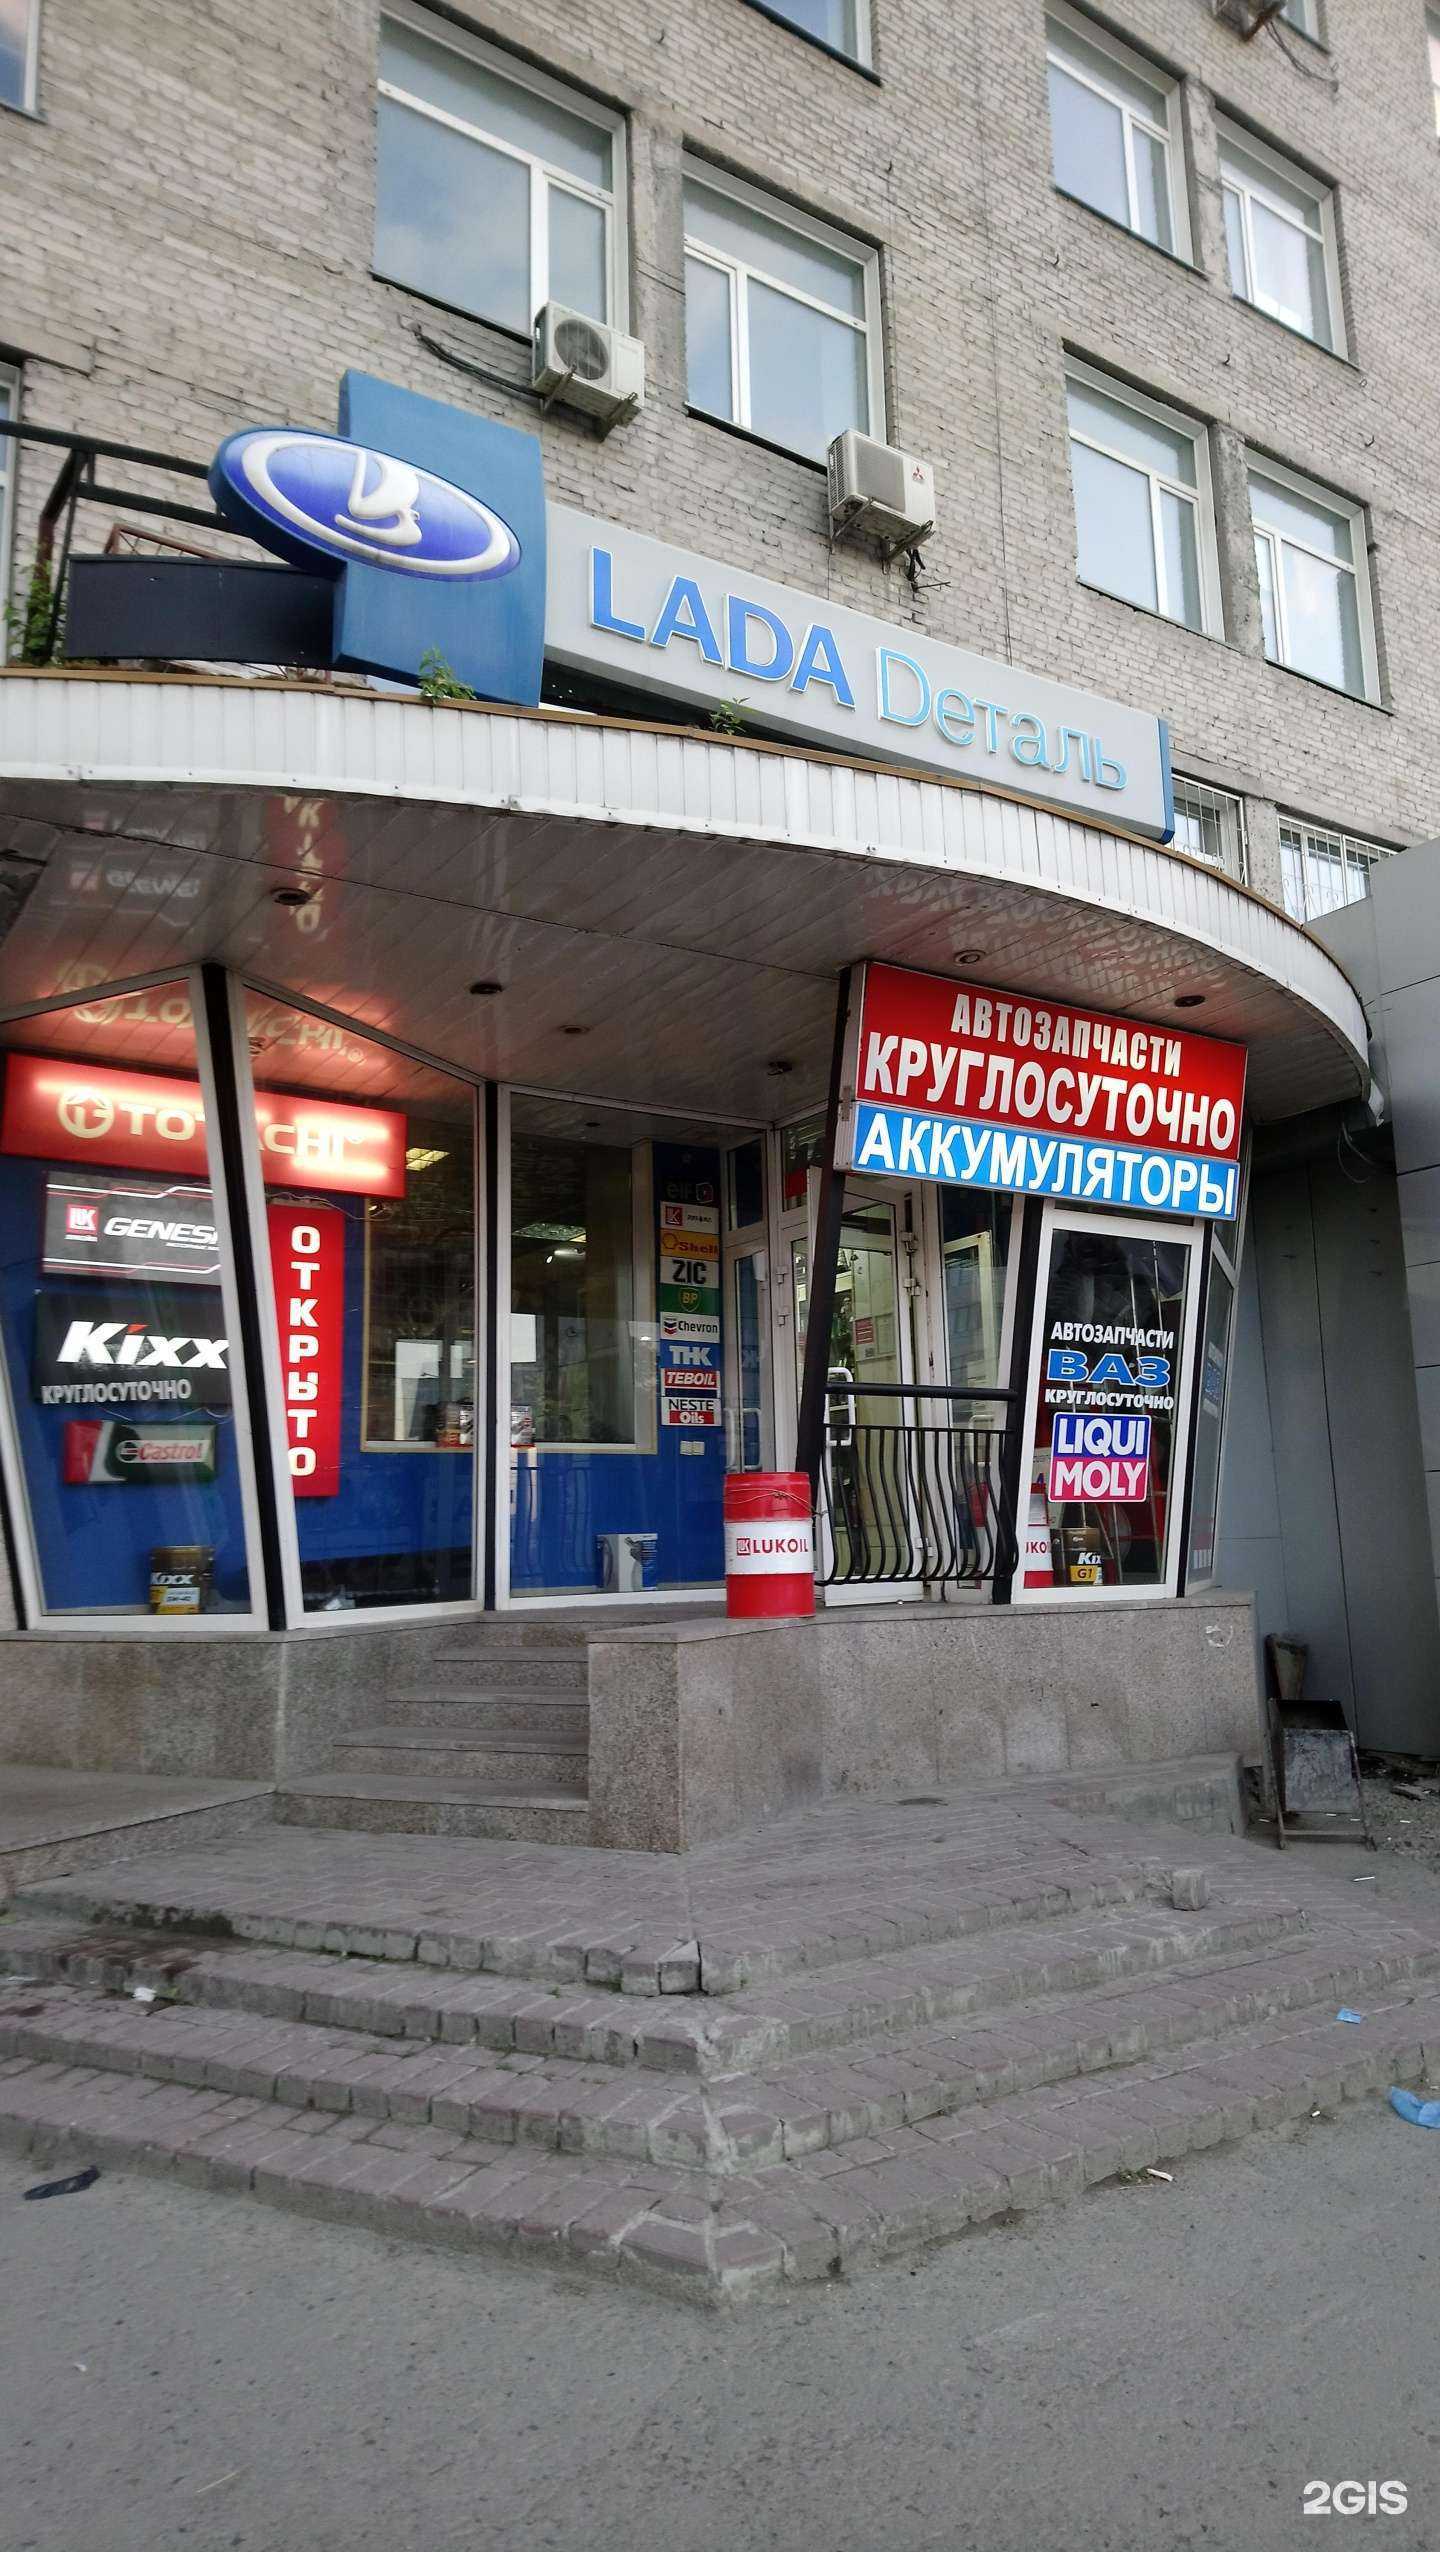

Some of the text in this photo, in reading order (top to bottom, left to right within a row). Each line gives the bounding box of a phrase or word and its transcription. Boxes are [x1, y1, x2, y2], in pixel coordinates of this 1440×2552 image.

[589, 543, 857, 712] LADA
[950, 994, 1182, 1078] АВТОЗАПЧАСТИ
[863, 1031, 1236, 1151] КРУГЛОСУТОЧНО
[858, 1112, 1234, 1215] АККУМУЛЯТОРЫ
[672, 1258, 708, 1285] ZIC
[682, 1292, 698, 1304] BP
[678, 1320, 718, 1334] Chevron
[1051, 1321, 1174, 1349] АВТОЗАПЧАСТИ
[56, 1320, 229, 1370] Kixx
[287, 1225, 321, 1477] ОТКРЫТО
[666, 1371, 716, 1386] TEBOIL
[1046, 1349, 1171, 1387] ВАЗ
[41, 1378, 192, 1404] КРУГЛОСУТОЧНО
[1044, 1388, 1174, 1410] КРУГЛОСУТОЧНО
[668, 1399, 714, 1412] NESTE
[680, 1412, 705, 1424] Oils
[1056, 1417, 1146, 1458] LIQUI
[140, 1441, 203, 1462] Castrol
[1055, 1461, 1146, 1498] MOLY
[752, 1538, 809, 1554] LUKOIL
